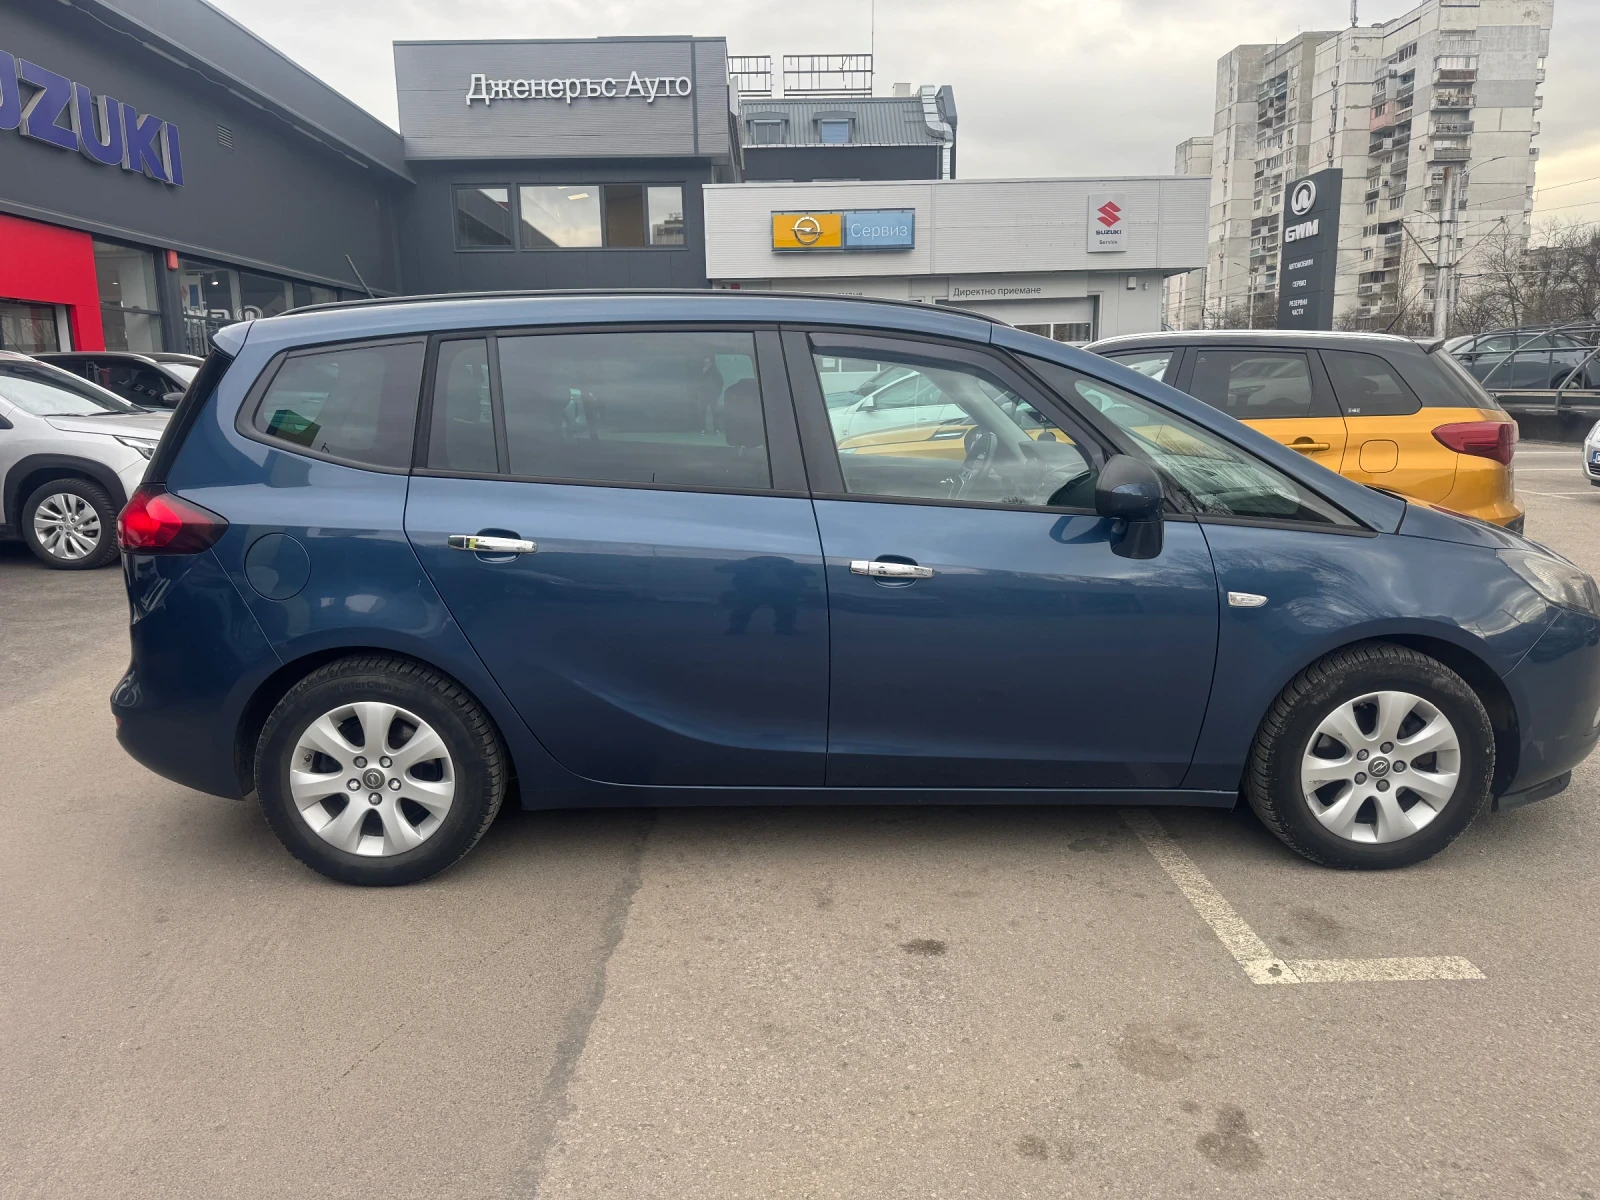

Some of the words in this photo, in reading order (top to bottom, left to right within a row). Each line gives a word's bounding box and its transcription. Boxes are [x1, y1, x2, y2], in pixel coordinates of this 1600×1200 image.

[466, 73, 616, 106] Дженеръс
[625, 71, 692, 103] Ауто
[851, 223, 908, 240] Сервиз
[1285, 219, 1319, 243] GWM
[953, 287, 996, 297] Директно
[997, 287, 1042, 296] приемане
